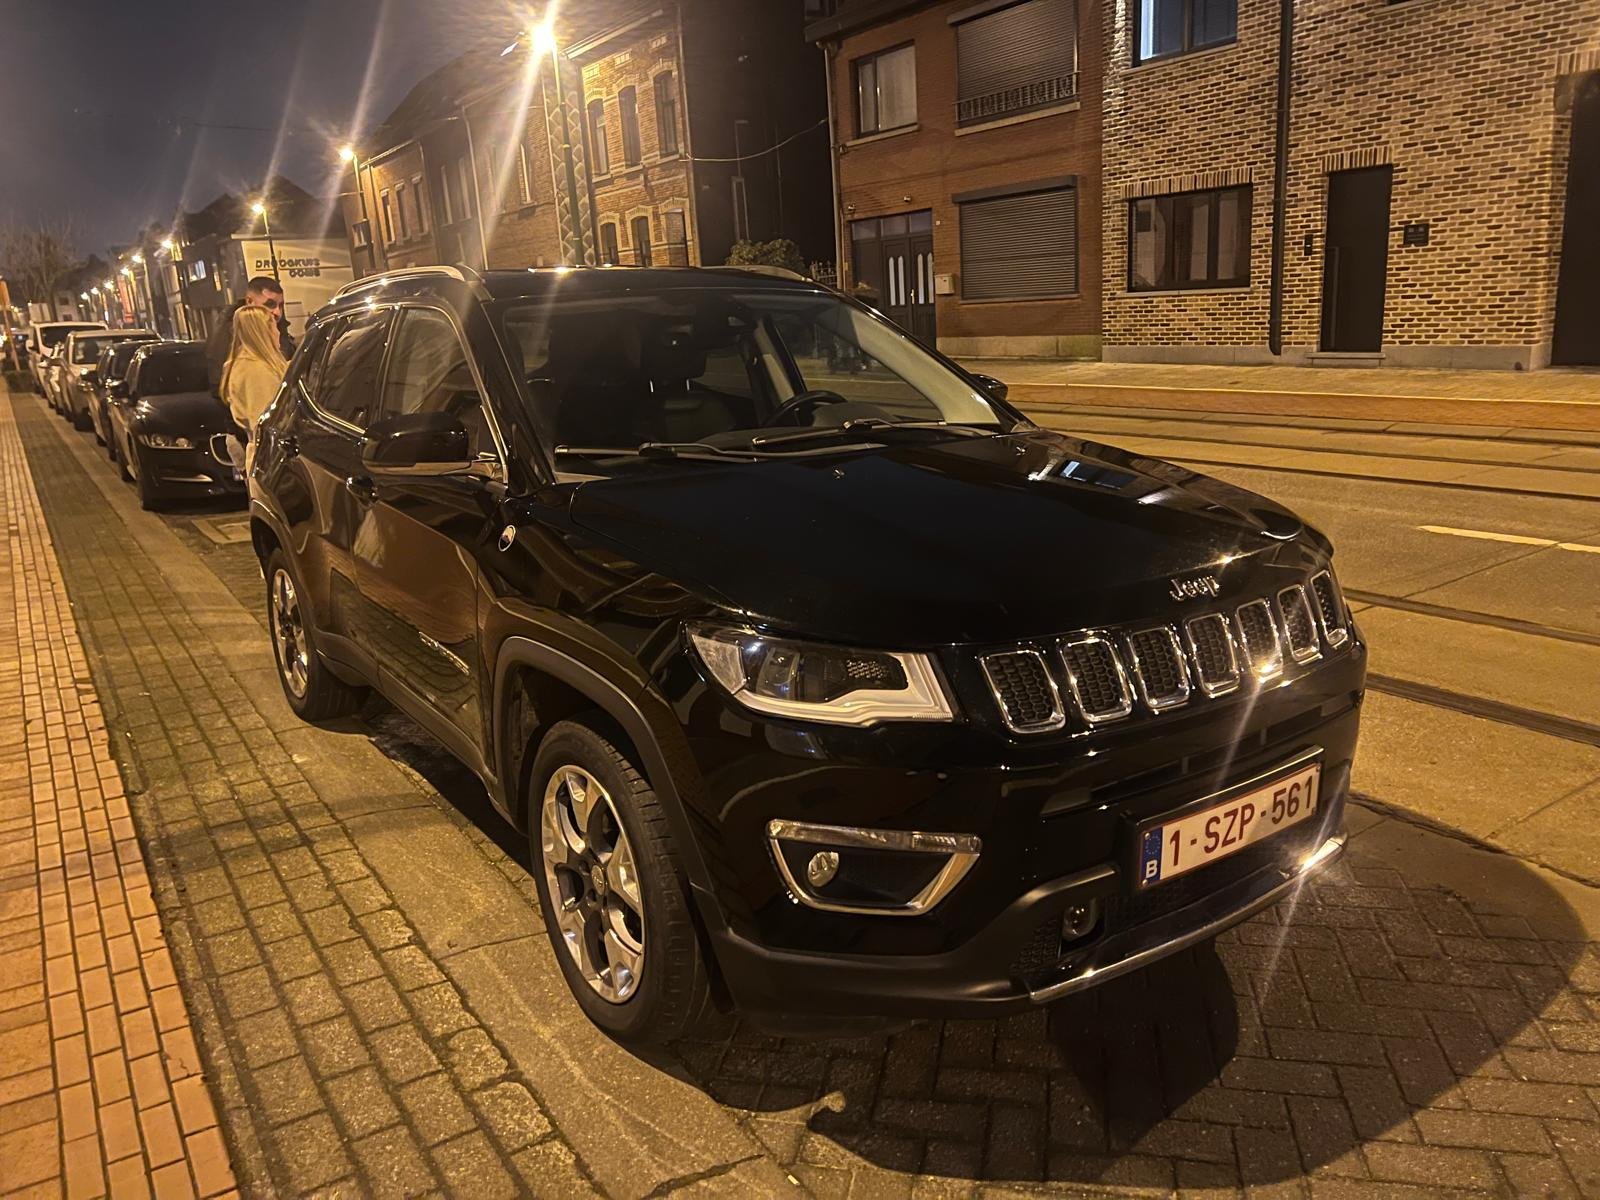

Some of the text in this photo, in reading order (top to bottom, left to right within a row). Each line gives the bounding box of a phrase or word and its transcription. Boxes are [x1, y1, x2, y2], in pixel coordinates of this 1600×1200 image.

[1169, 575, 1220, 601] Jeep
[1145, 775, 1313, 879] B 1-SZP-561
